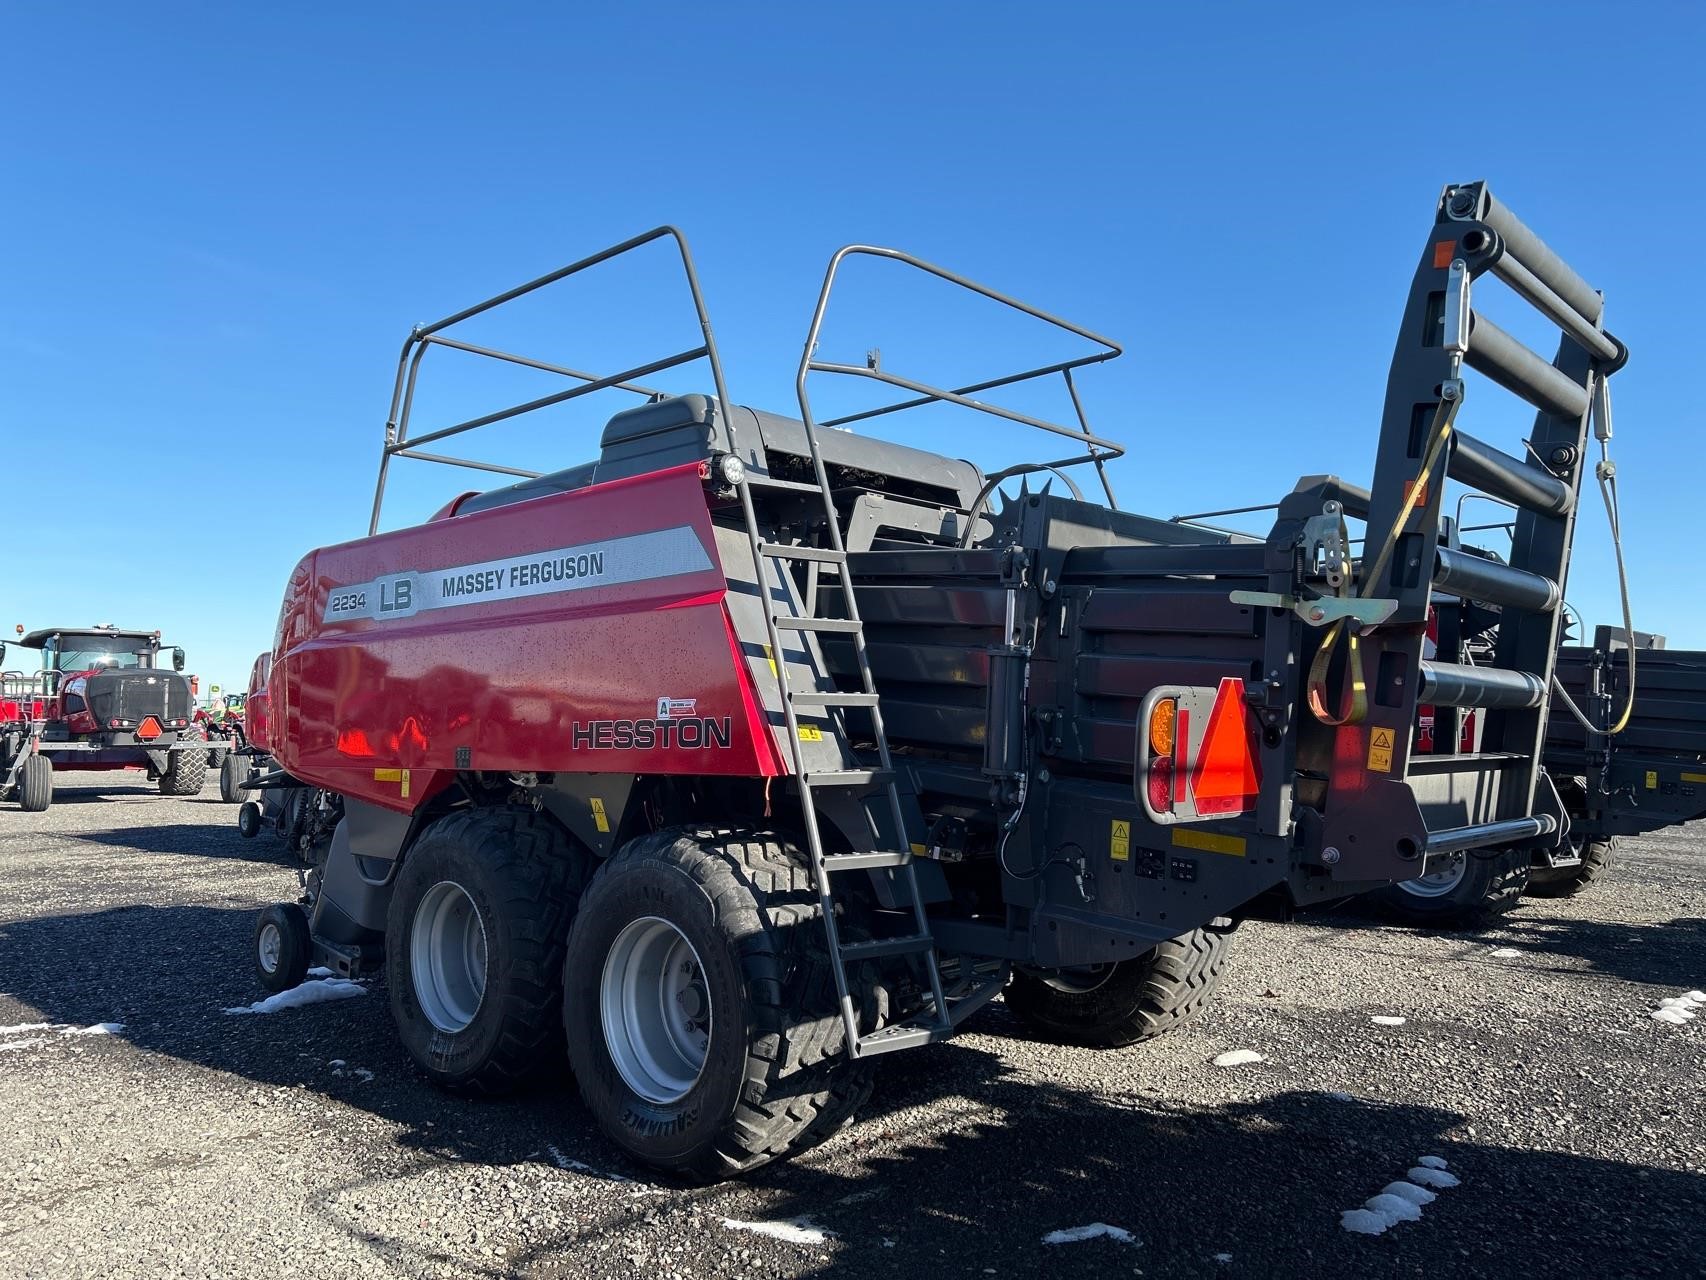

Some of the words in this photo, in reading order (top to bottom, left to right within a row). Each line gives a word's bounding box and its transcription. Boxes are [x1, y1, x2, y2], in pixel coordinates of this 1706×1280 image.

[332, 593, 366, 612] 2234
[379, 579, 412, 612] LB
[442, 569, 505, 598] MASSEY
[510, 552, 603, 588] FERGUSON
[572, 717, 732, 749] HESSTON
